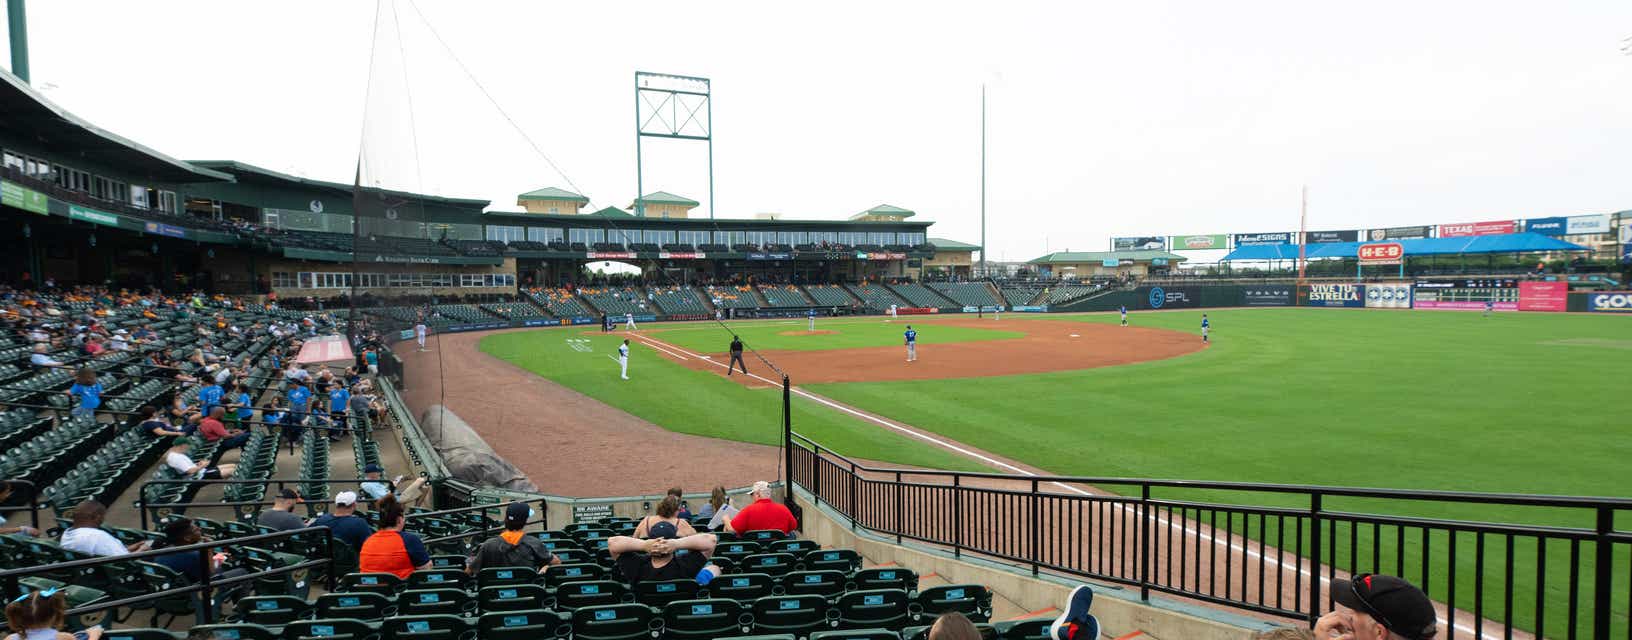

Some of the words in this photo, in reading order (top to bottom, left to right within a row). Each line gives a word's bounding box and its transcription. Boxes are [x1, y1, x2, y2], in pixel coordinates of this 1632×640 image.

[1444, 225, 1473, 234] TEXAS
[1311, 284, 1336, 293] VIVE
[1338, 283, 1352, 293] TU
[1166, 292, 1190, 303] SPL
